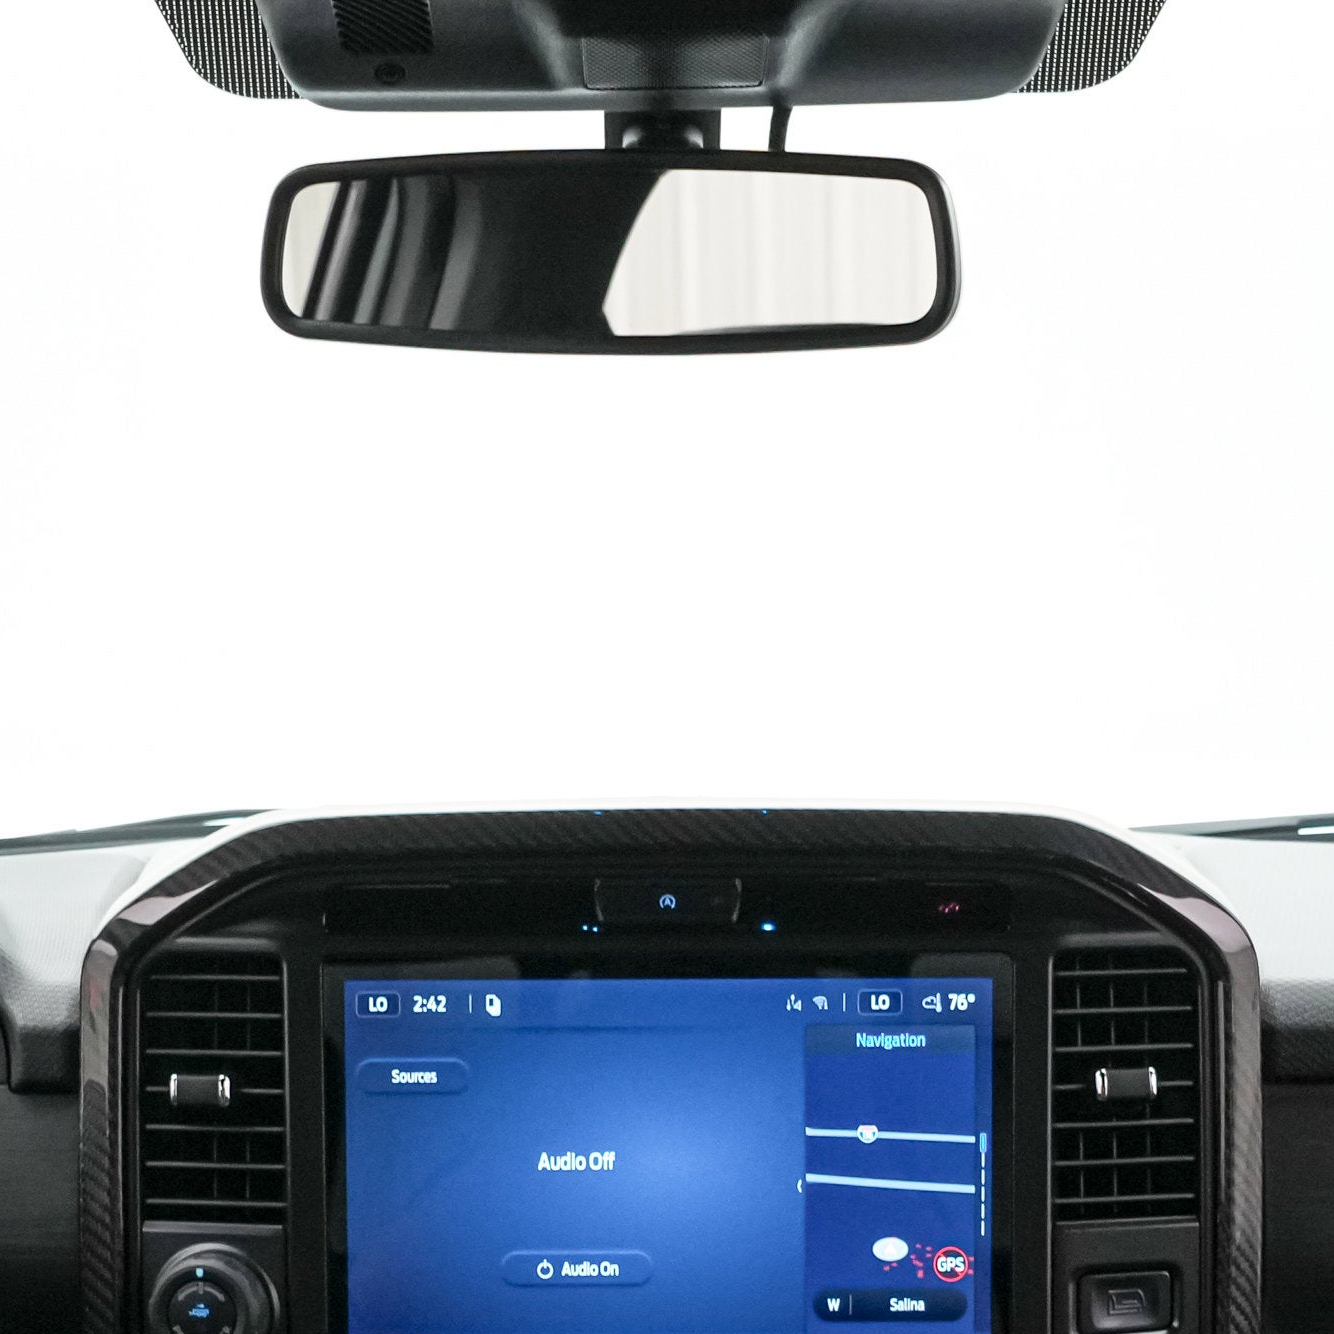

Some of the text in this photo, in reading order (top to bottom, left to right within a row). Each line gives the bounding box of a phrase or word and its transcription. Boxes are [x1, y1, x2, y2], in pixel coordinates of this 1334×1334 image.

[368, 995, 447, 1013] LO 2:42
[870, 994, 891, 1011] LO
[855, 1032, 927, 1051] Navigation
[391, 1068, 438, 1084] Sources
[537, 1152, 616, 1171] Audio Off
[560, 1260, 620, 1277] Audio On
[936, 1257, 965, 1273] GPS
[826, 1297, 926, 1312] W Salina
